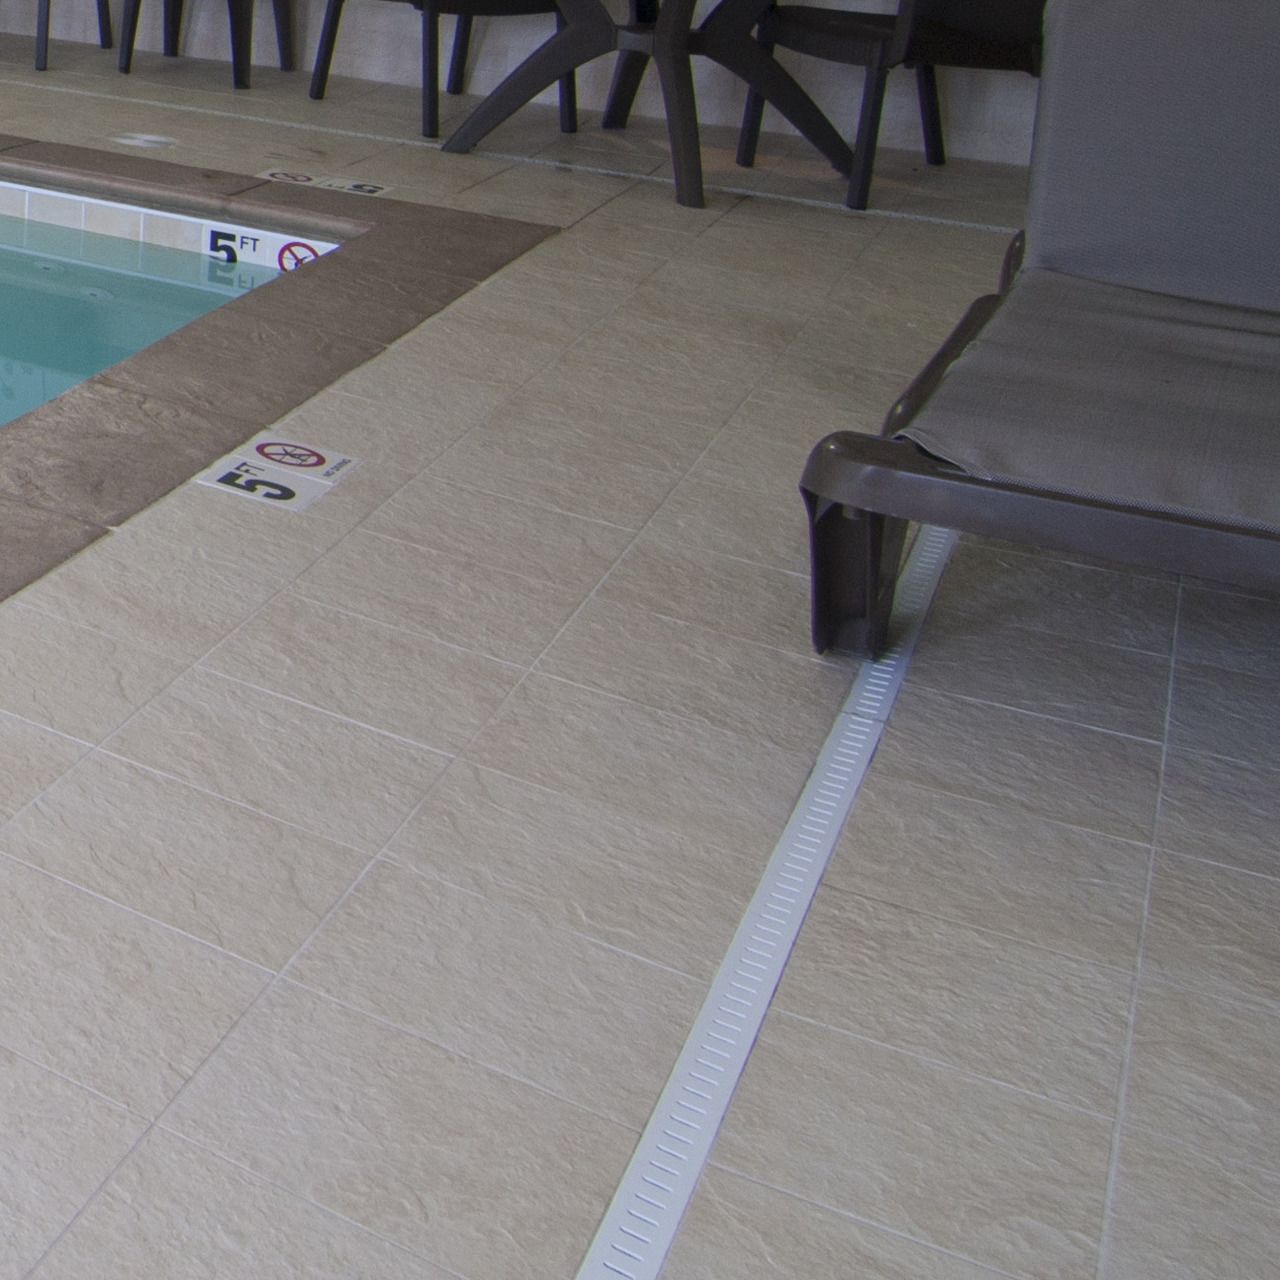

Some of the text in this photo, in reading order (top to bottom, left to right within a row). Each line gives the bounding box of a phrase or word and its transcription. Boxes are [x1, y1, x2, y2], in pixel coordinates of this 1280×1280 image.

[208, 229, 259, 263] 5 FT
[216, 461, 296, 500] 5 FT
